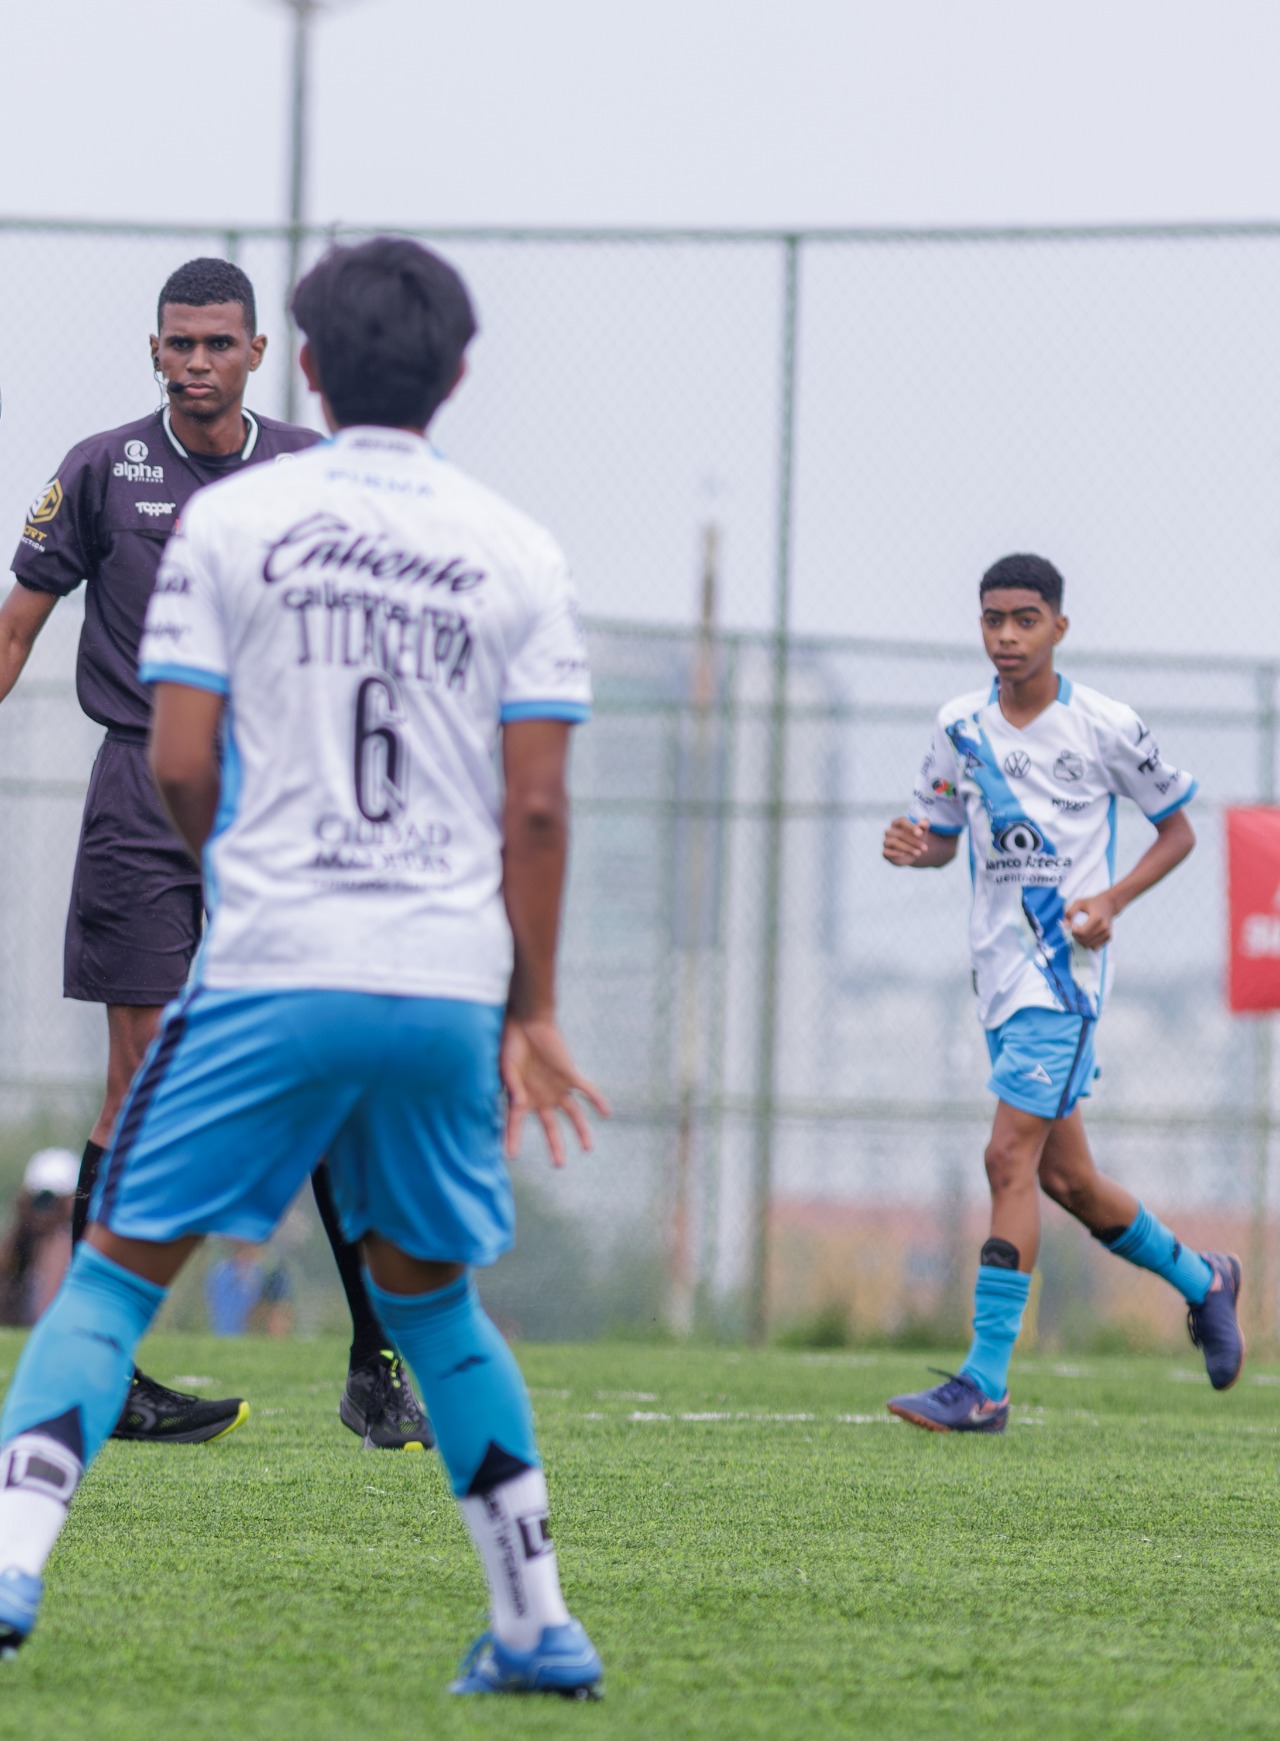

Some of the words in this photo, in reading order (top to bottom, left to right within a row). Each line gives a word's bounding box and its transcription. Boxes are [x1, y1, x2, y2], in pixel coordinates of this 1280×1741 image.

[113, 461, 164, 481] alpha
[263, 512, 487, 593] Caliente
[354, 676, 408, 824] 6
